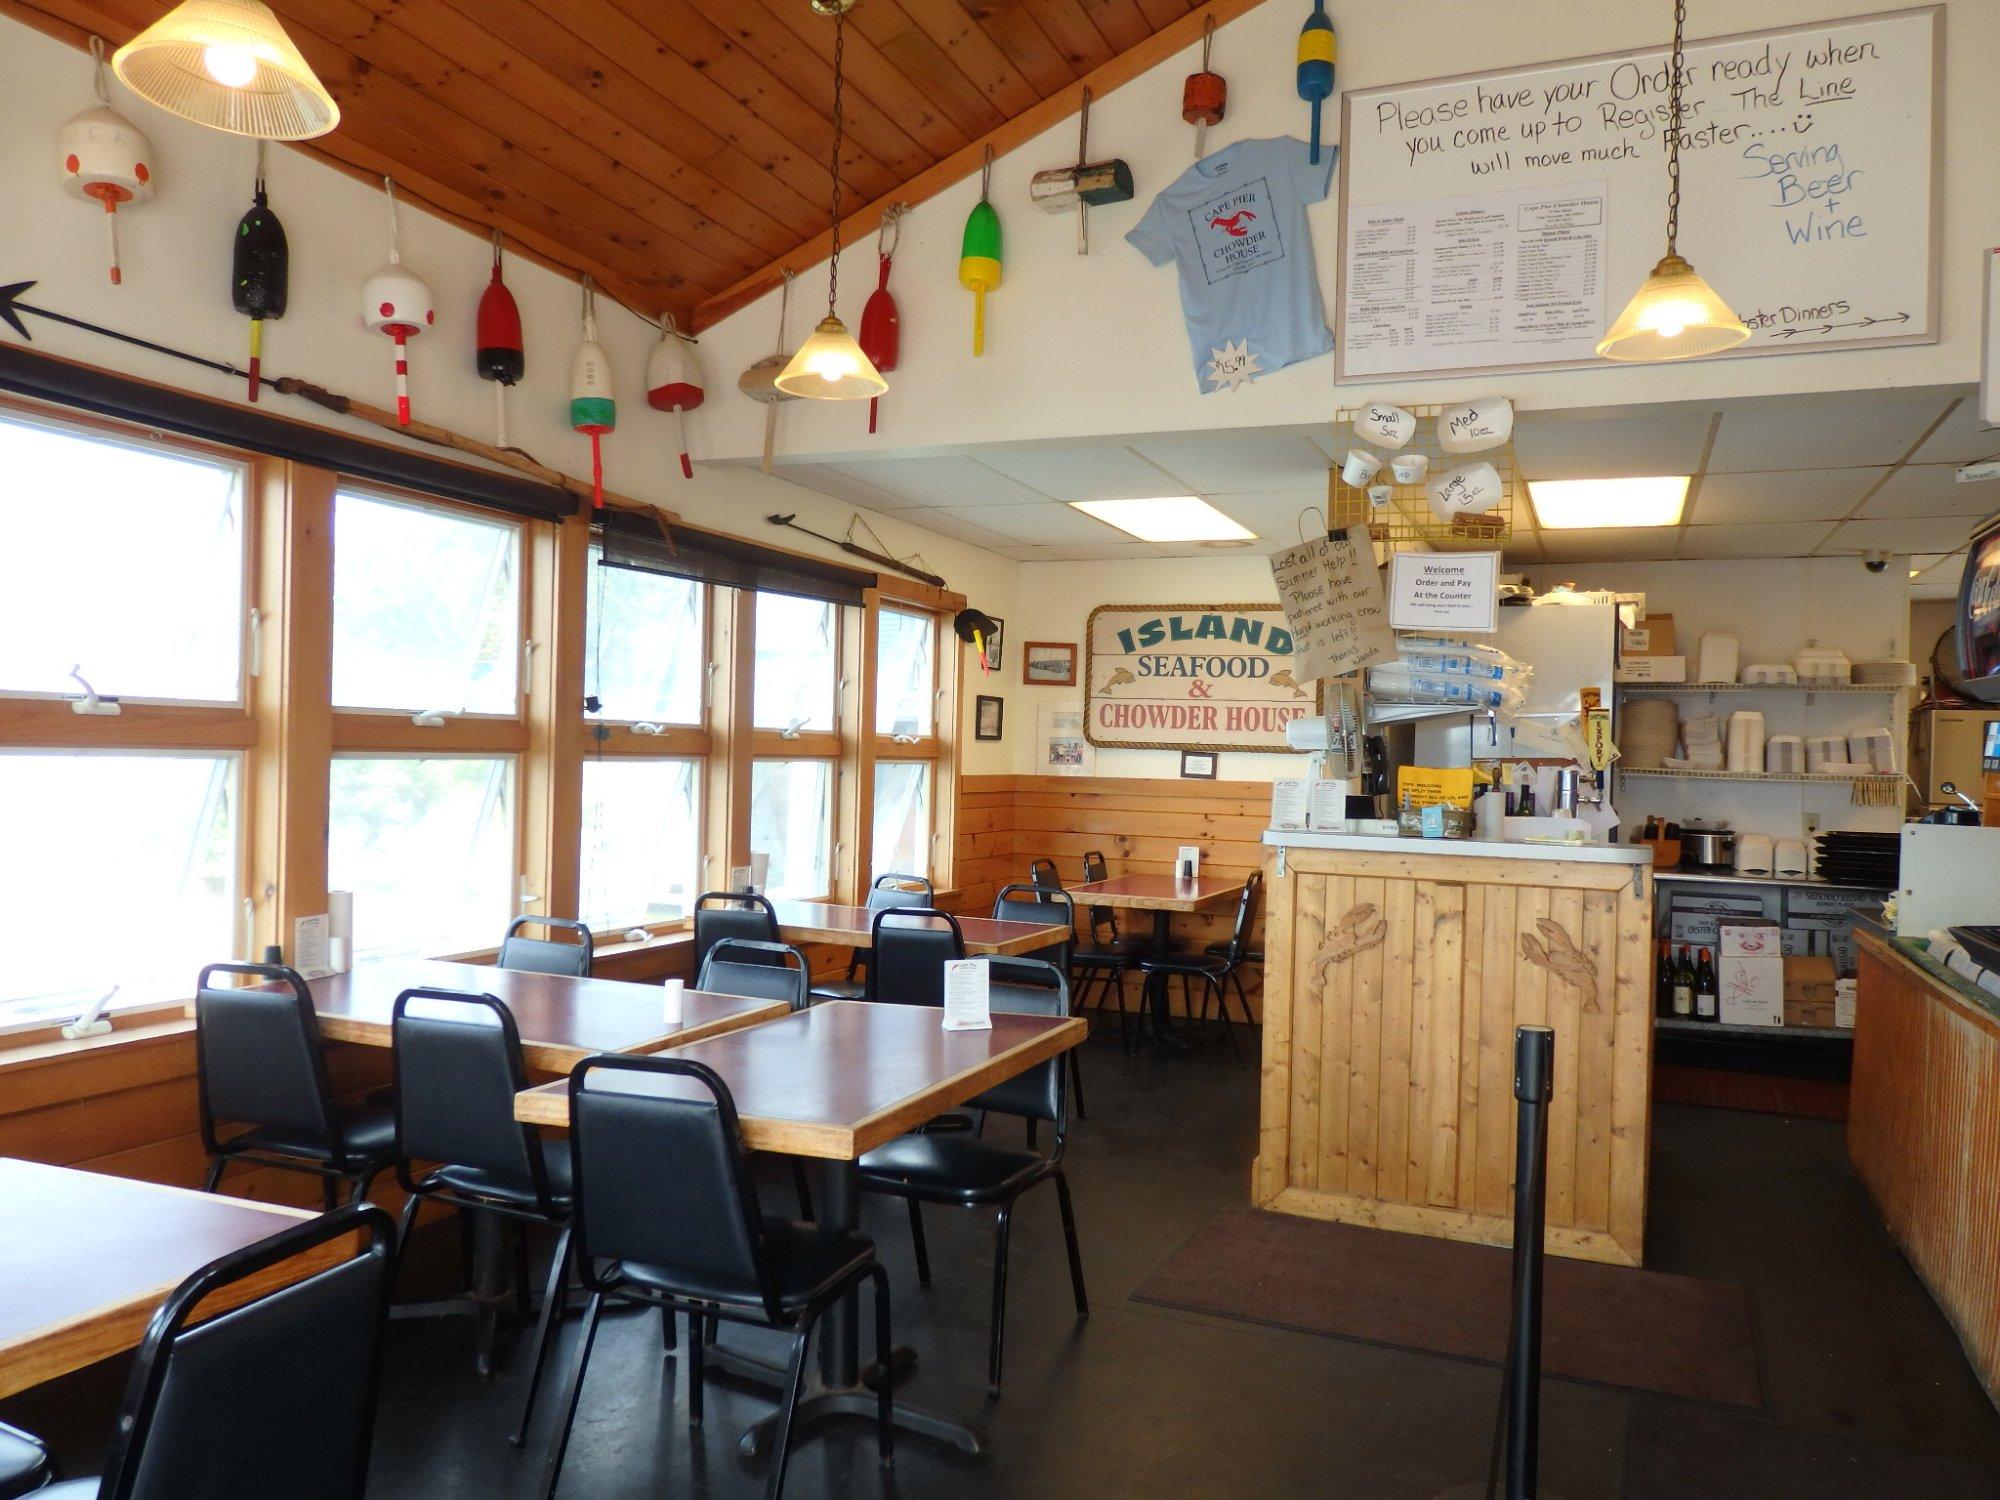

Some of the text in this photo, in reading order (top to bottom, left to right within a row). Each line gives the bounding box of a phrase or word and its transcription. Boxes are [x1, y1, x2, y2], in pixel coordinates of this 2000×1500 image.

[1377, 38, 1880, 133] Please have your Order ready when
[1406, 134, 1445, 167] you
[1453, 124, 1510, 149] come
[1520, 120, 1547, 144] up
[1552, 111, 1582, 136] to
[1731, 86, 1784, 111] The
[1800, 75, 1856, 102] Line
[1471, 151, 1510, 175] will
[1525, 150, 1572, 169] move
[1581, 137, 1641, 162] much
[1737, 143, 1844, 180] Serving
[1769, 169, 1866, 207] Beer
[1204, 192, 1256, 222] CAPE PIER
[1785, 211, 1868, 245] Wine
[1213, 230, 1266, 259] CHOWDER
[1225, 245, 1260, 264] HOUSE
[1779, 300, 1850, 324] Dinners
[1370, 408, 1400, 424] Small
[1450, 408, 1478, 435] Med
[1438, 474, 1466, 503] Large
[1270, 552, 1297, 573] Lost
[1299, 545, 1316, 565] all
[1319, 541, 1329, 557] of
[1424, 565, 1465, 575] Welcome
[1277, 566, 1319, 591] Summer
[1323, 556, 1346, 572] Help
[1416, 579, 1472, 588] Order and Pay
[1289, 575, 1353, 604] Please have
[1413, 591, 1472, 600] At the Counter
[1287, 586, 1373, 625] patience with our
[1315, 611, 1356, 629] working
[1117, 613, 1294, 655] ISLAND
[1316, 639, 1326, 648] is
[1138, 655, 1270, 679] SEAFOOD
[1328, 645, 1360, 664] Thanks
[1188, 679, 1214, 699] &
[1100, 703, 1218, 731] CHOWDER
[1595, 721, 1604, 763] EXPORT
[1688, 925, 1712, 935] OYSTER
